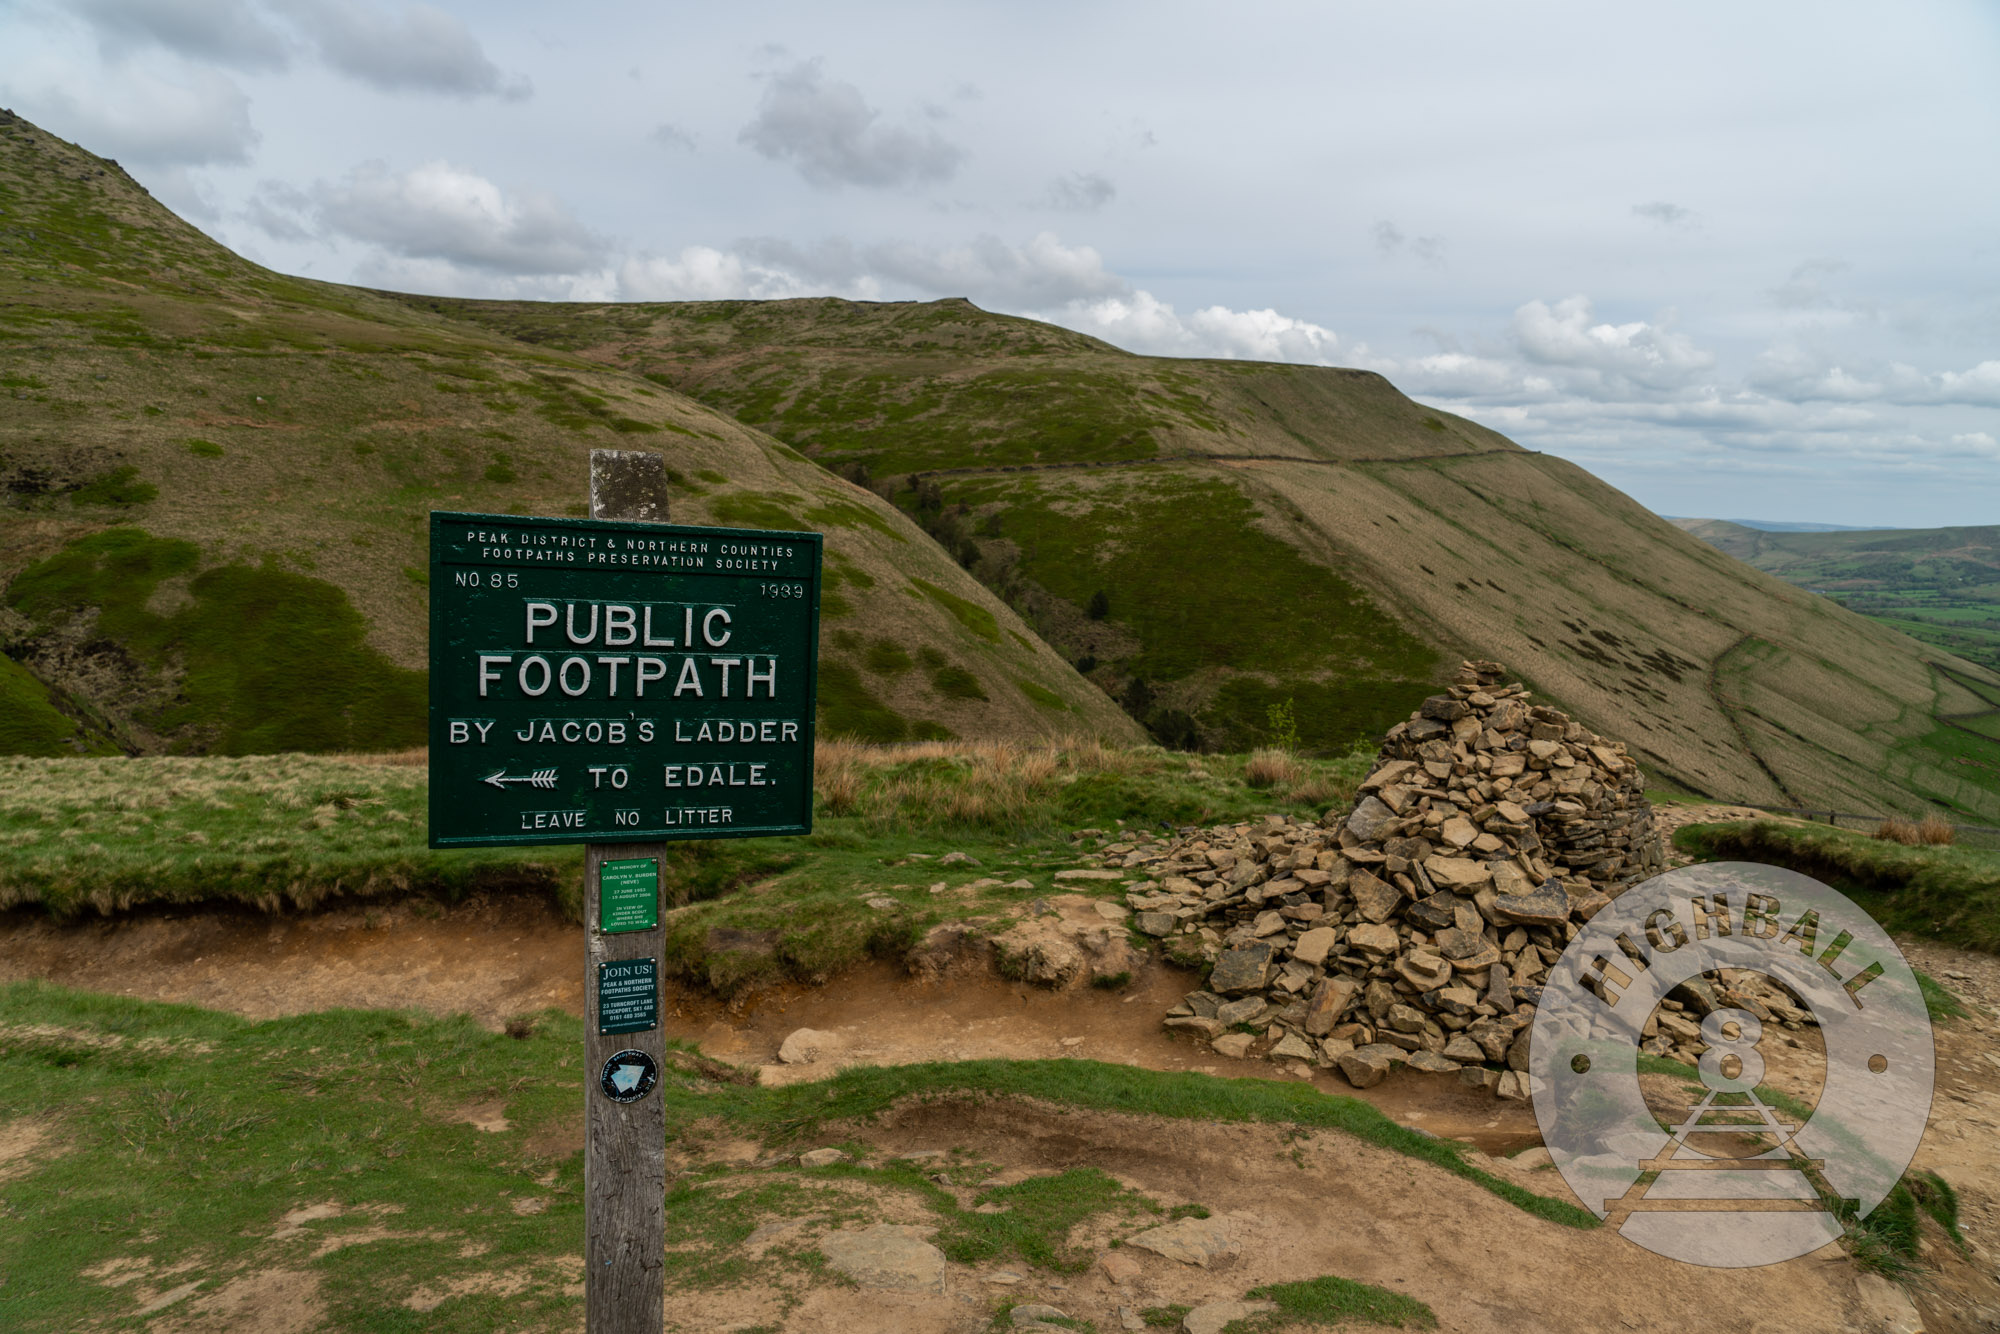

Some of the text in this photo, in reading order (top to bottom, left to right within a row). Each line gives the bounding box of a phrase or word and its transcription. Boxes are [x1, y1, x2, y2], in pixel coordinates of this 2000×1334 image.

[467, 531, 794, 558] PEAK DISTRICT & NORTHERN COUNTIES
[482, 548, 779, 571] FOOTPATHS PRESERVATION SOCIETY
[455, 572, 519, 589] NO 85
[524, 602, 732, 647] PUBLIC
[478, 655, 777, 698] FOOTPATH
[449, 712, 799, 745] BY JACOB'S LADDER
[588, 764, 777, 789] TO EDALE.
[521, 809, 733, 829] LEAVE NO LITTER
[603, 965, 652, 980] JOIN US!
